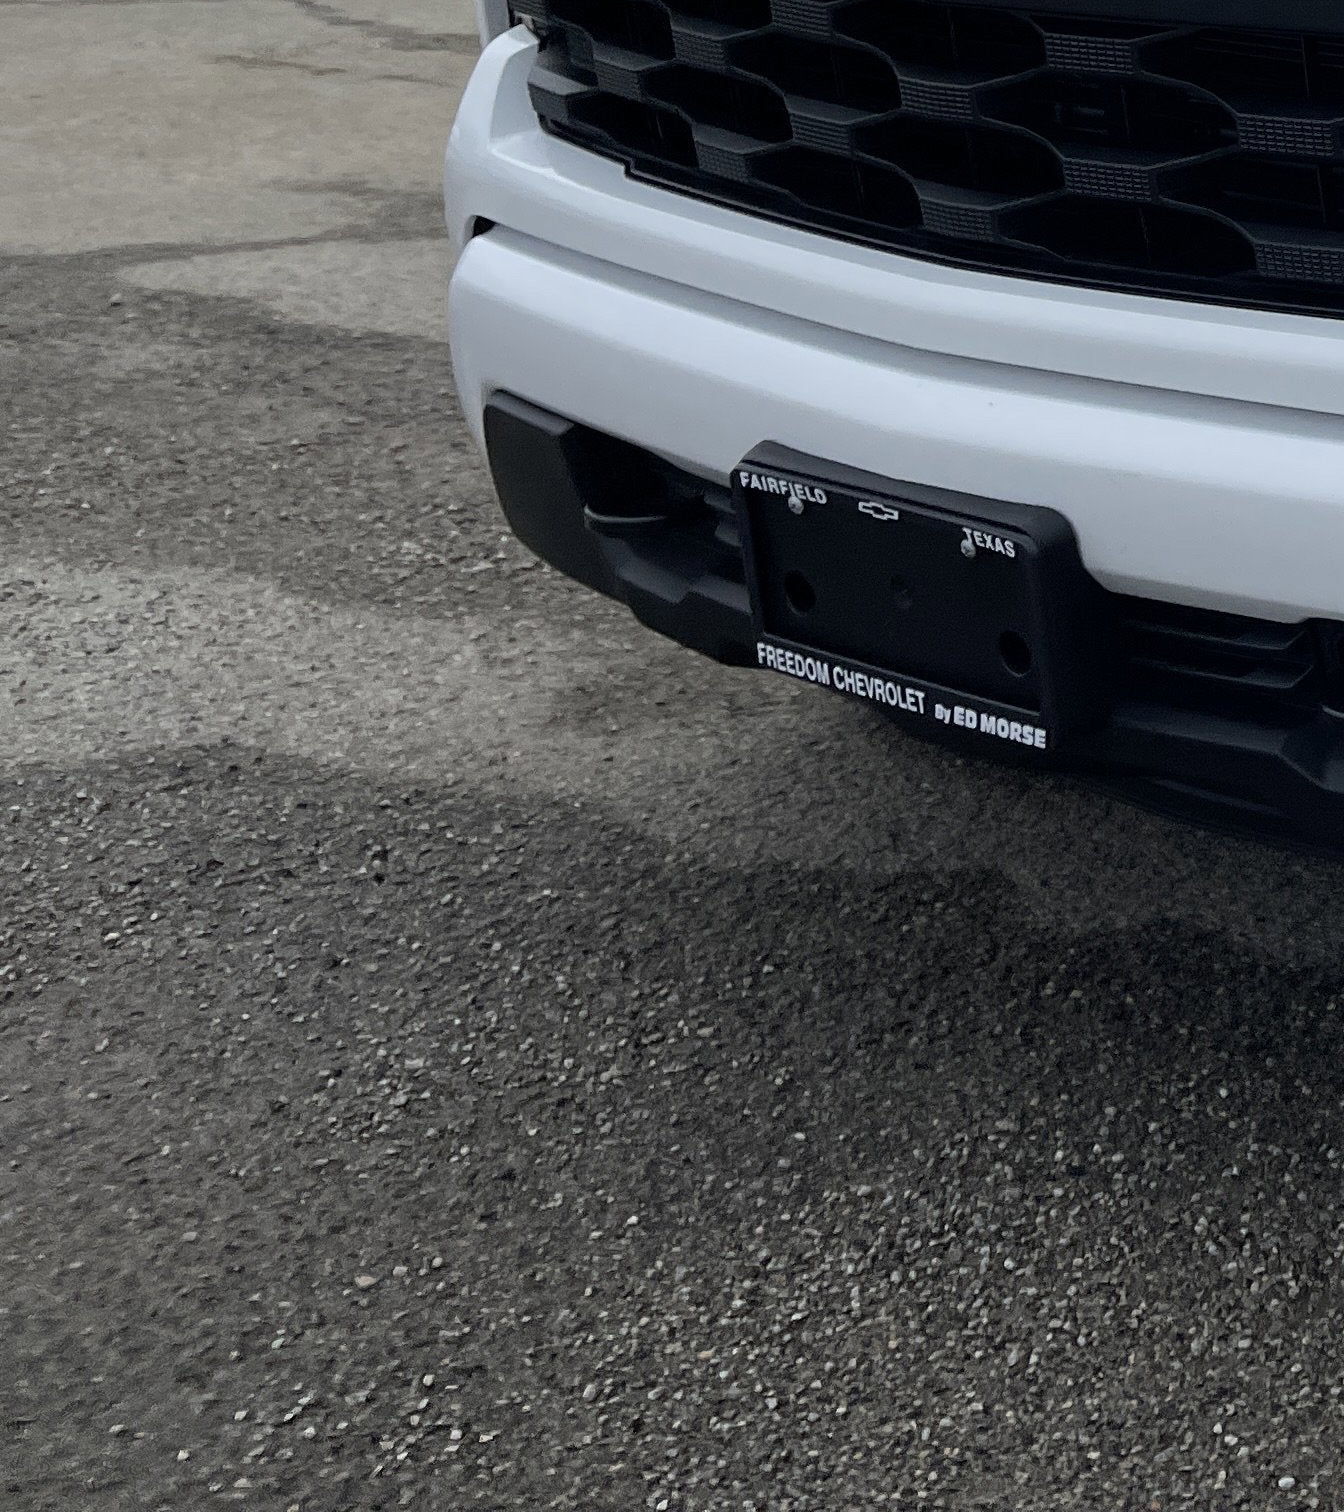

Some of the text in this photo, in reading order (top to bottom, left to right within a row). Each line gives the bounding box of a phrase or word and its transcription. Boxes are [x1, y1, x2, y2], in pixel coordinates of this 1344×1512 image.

[739, 471, 827, 506] FAIRFIELD
[961, 527, 1016, 558] TEXAS
[756, 641, 831, 686] FREEDOM
[832, 665, 926, 715] CHEVROLET
[953, 706, 978, 730] ED
[979, 712, 1047, 749] MORSE
